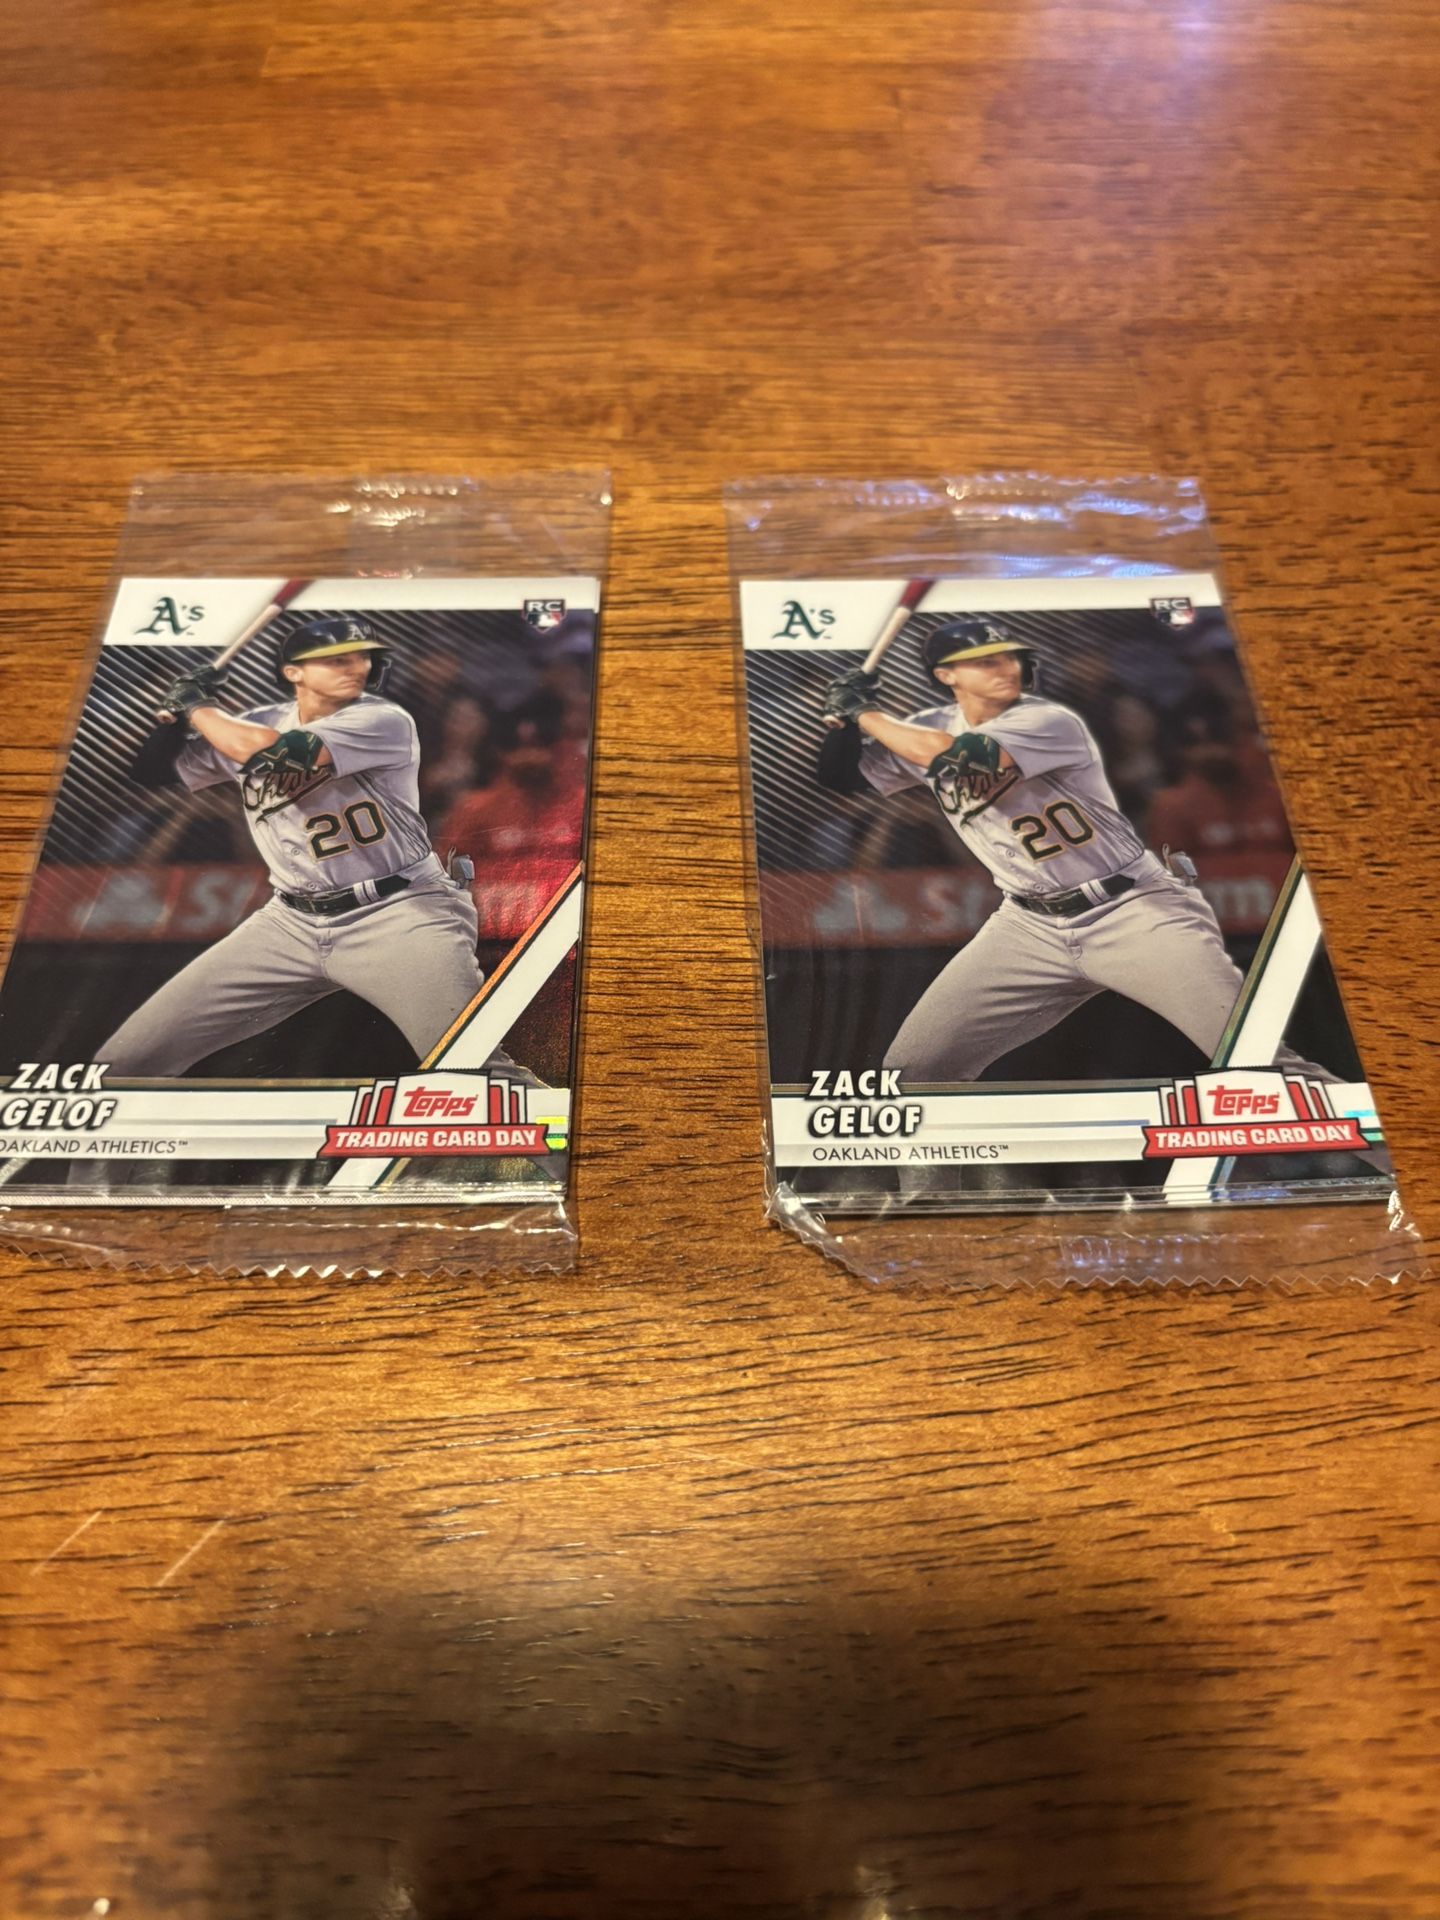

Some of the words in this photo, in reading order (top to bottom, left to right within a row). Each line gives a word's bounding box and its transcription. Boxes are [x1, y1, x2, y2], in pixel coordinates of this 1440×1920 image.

[134, 597, 205, 636] A's
[527, 601, 562, 612] RC
[1154, 599, 1188, 611] RC
[772, 600, 836, 640] A's
[305, 800, 387, 862] 20
[1010, 800, 1094, 862] 20
[8, 1063, 110, 1090] ZACK
[808, 1070, 902, 1097] ZACK
[1, 1099, 117, 1128] GELOF
[811, 1105, 922, 1135] GELOF
[335, 1131, 431, 1148] TRADING
[433, 1130, 491, 1147] CARD
[496, 1129, 537, 1146] DAY
[1155, 1131, 1247, 1149] TRADING
[1250, 1127, 1308, 1145] CARD
[1310, 1125, 1353, 1142] DAY
[812, 1147, 901, 1161] OAKLAND
